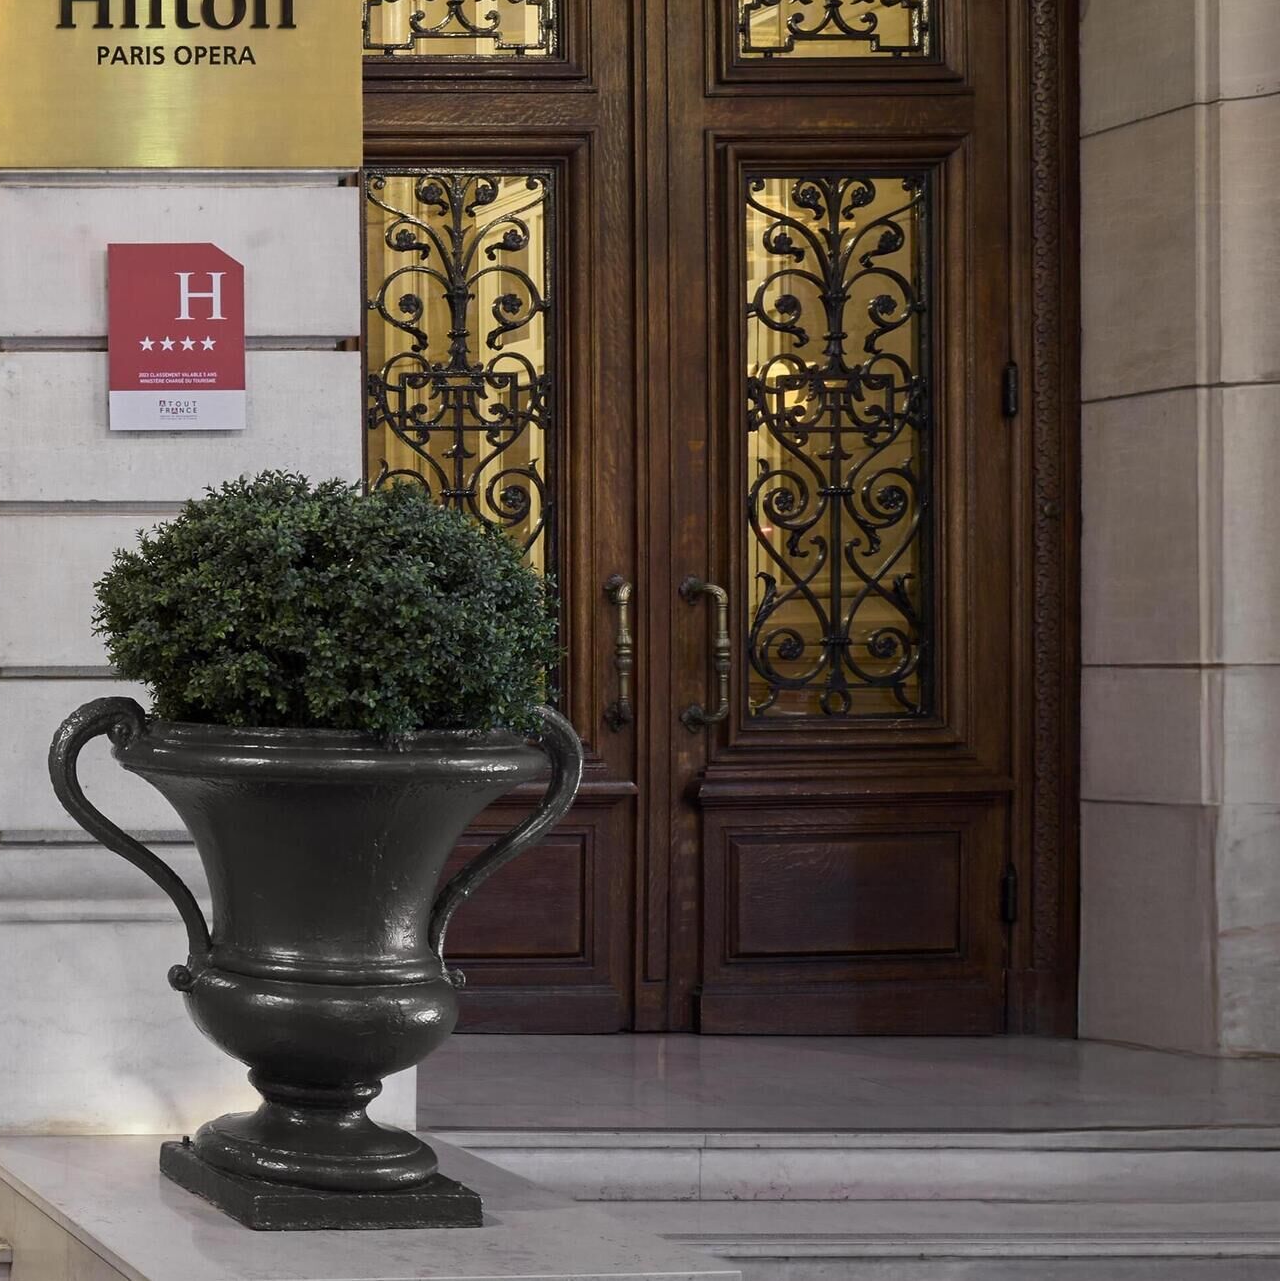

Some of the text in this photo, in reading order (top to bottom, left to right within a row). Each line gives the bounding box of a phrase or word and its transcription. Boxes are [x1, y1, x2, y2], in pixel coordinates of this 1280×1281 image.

[97, 46, 257, 66] PARIS OPERA
[174, 271, 228, 320] H
[159, 407, 198, 415] FRANCE
